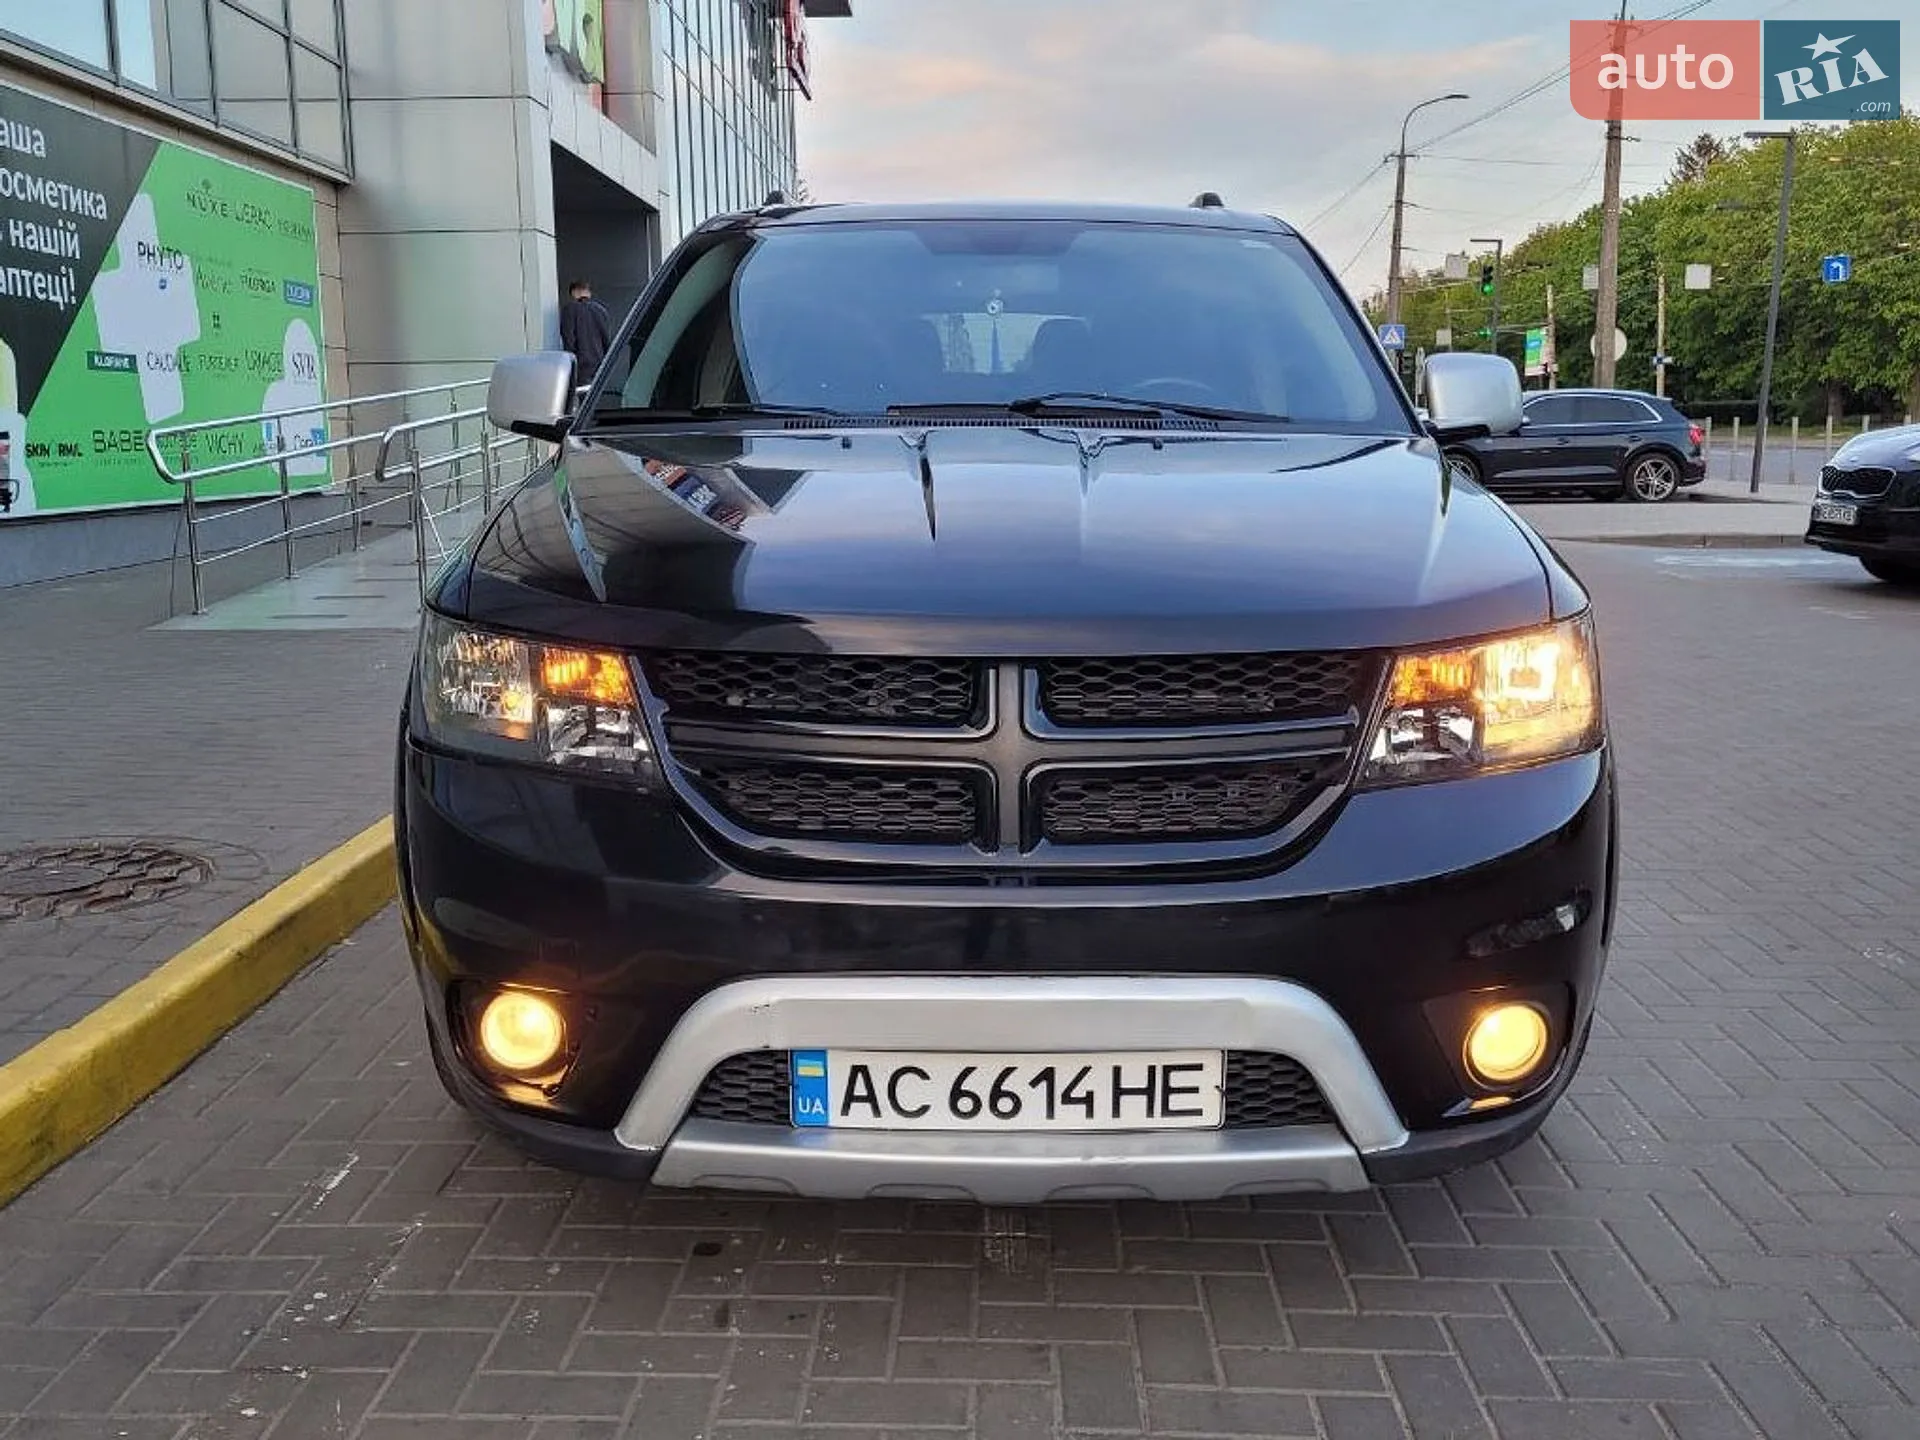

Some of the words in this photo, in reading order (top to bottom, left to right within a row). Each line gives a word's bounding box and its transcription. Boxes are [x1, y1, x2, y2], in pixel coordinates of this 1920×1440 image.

[9, 219, 81, 260] нашій
[138, 240, 184, 270] PHYTO
[204, 431, 244, 455] VICHY
[797, 1097, 825, 1116] UA
[839, 1064, 932, 1120] AC
[948, 1065, 1096, 1121] 6614
[1110, 1062, 1205, 1119] HE
